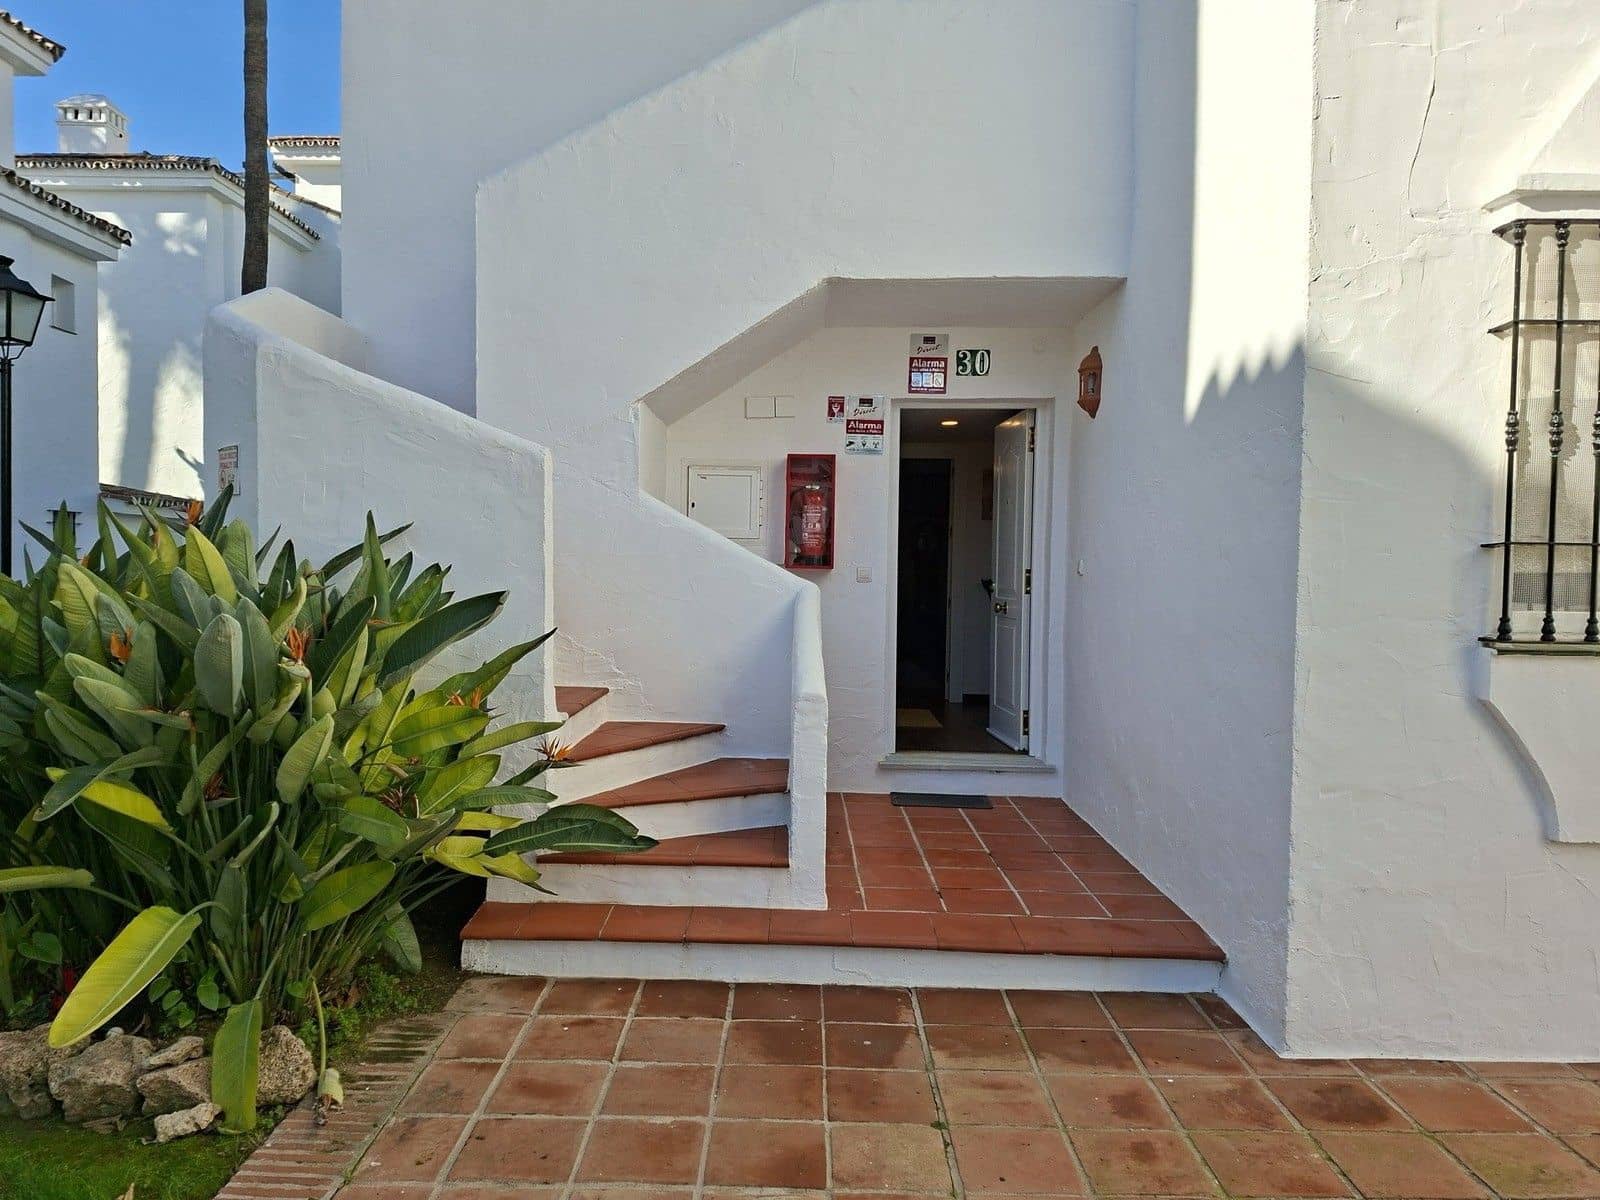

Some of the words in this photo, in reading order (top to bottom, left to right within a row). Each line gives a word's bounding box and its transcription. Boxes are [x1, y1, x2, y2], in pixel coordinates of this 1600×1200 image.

[911, 359, 945, 368] Alarma
[957, 350, 990, 375] 30
[848, 420, 882, 429] Alarma
